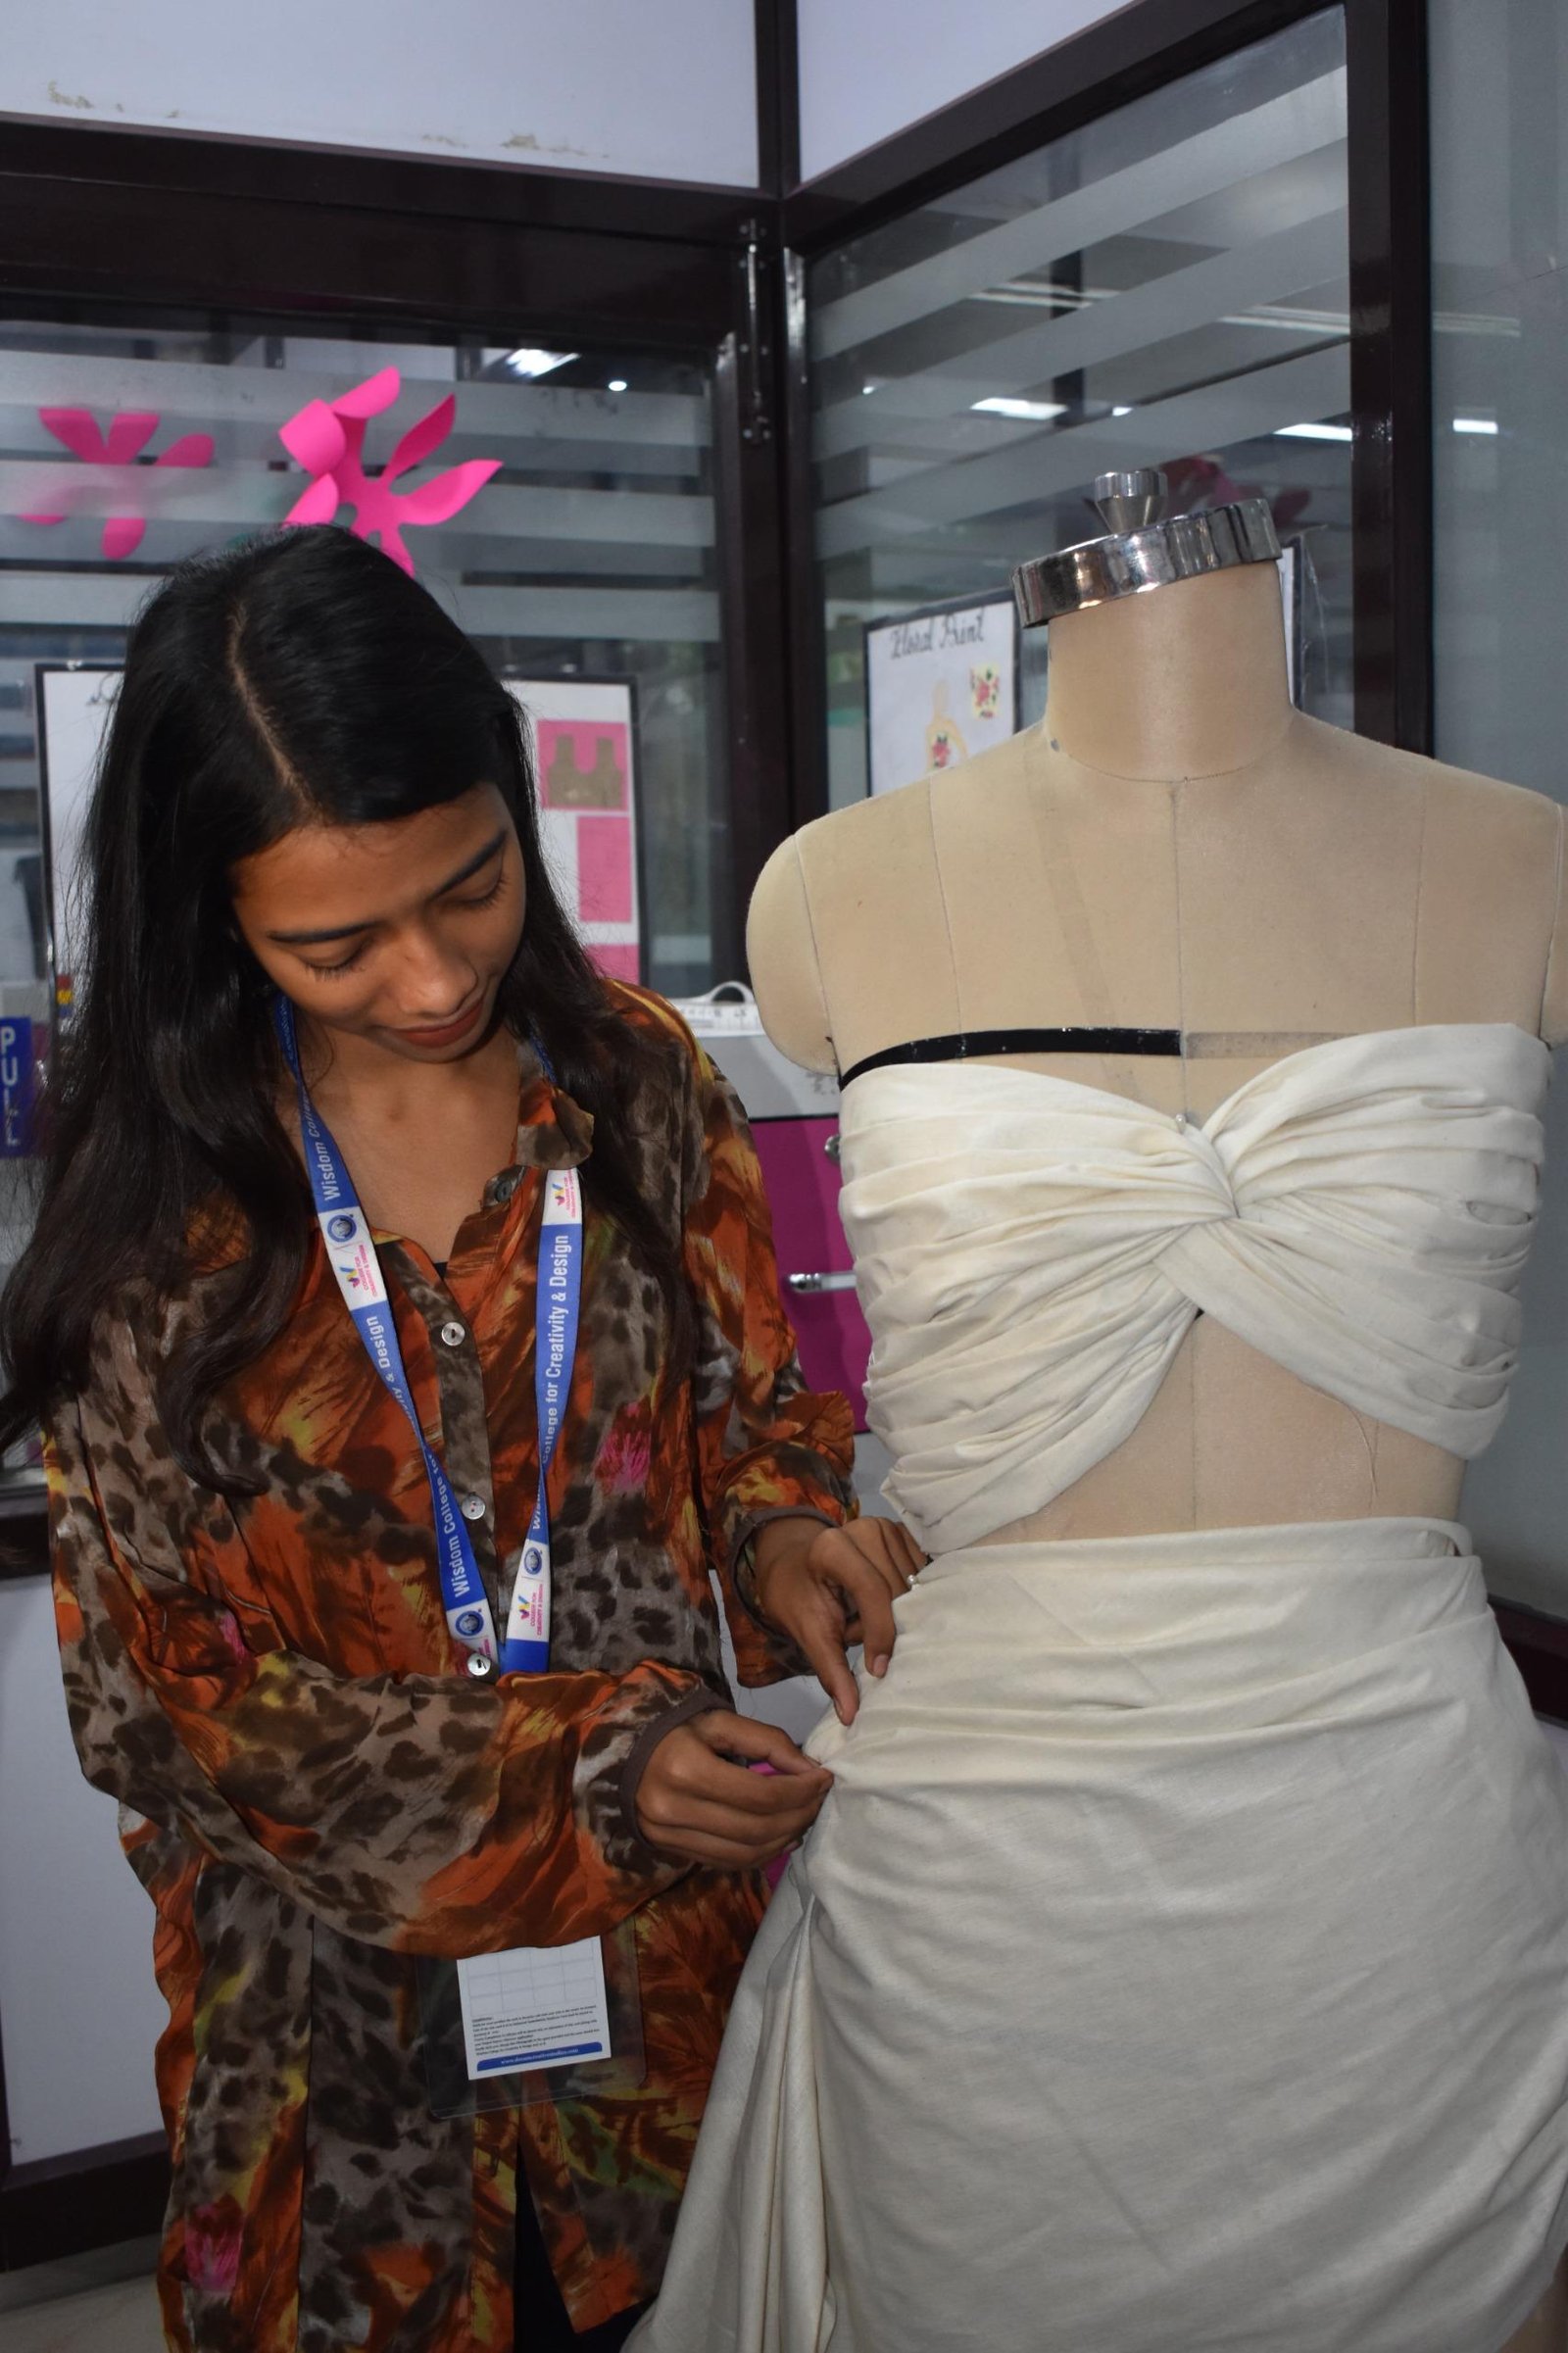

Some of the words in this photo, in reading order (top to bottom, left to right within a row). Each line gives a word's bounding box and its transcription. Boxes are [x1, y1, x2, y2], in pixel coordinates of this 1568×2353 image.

[316, 1142, 341, 1201] Wisdom
[549, 1235, 571, 1287] Design
[551, 1292, 567, 1302] &
[366, 1316, 391, 1369] Design
[546, 1307, 569, 1377] Creativity
[385, 1373, 396, 1384] &
[545, 1382, 559, 1402] for
[542, 1407, 559, 1464] College
[437, 1478, 456, 1535] College
[449, 1535, 470, 1599] Wisdom
